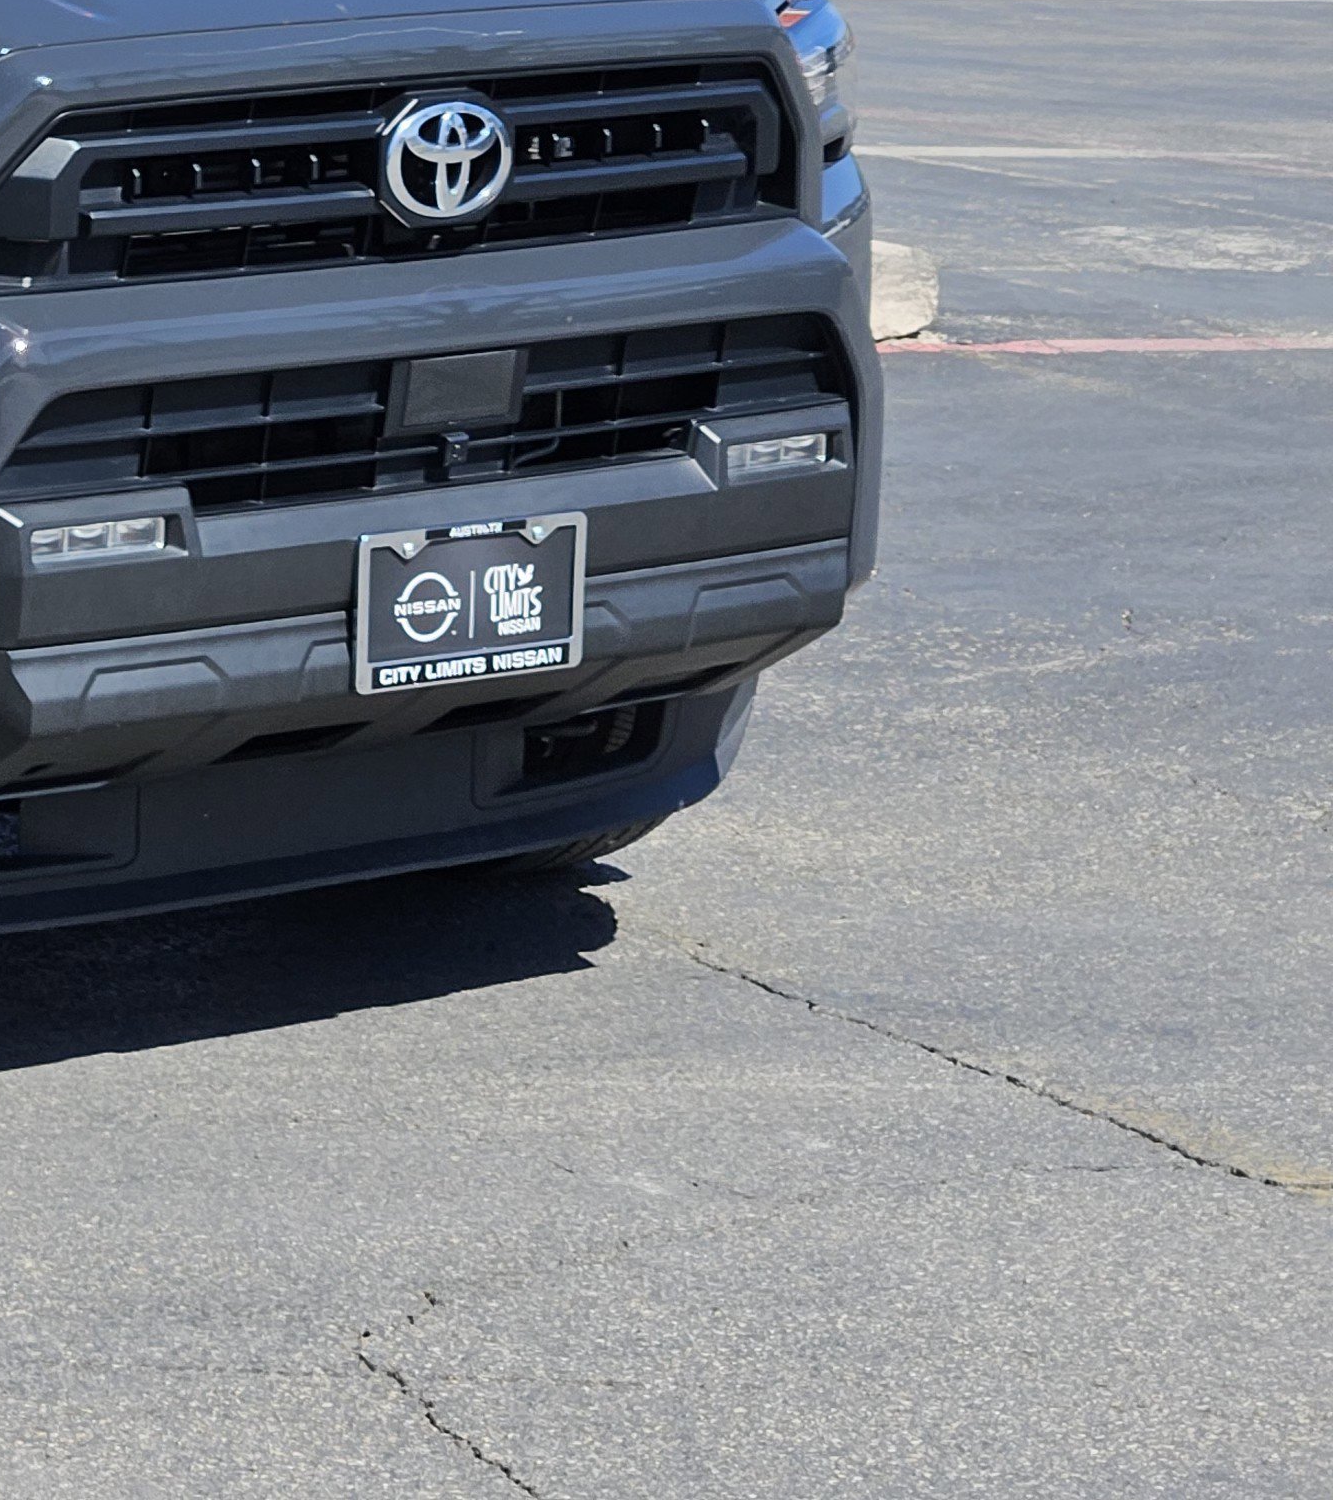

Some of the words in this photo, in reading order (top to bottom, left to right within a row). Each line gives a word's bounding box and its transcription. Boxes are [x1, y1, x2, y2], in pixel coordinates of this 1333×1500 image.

[394, 598, 461, 617] NISSAN
[490, 586, 543, 622] LIMITS
[498, 617, 541, 636] NISSAN
[379, 665, 422, 686] CITY
[425, 657, 486, 680] LIMITS
[492, 647, 563, 671] NISSAN
